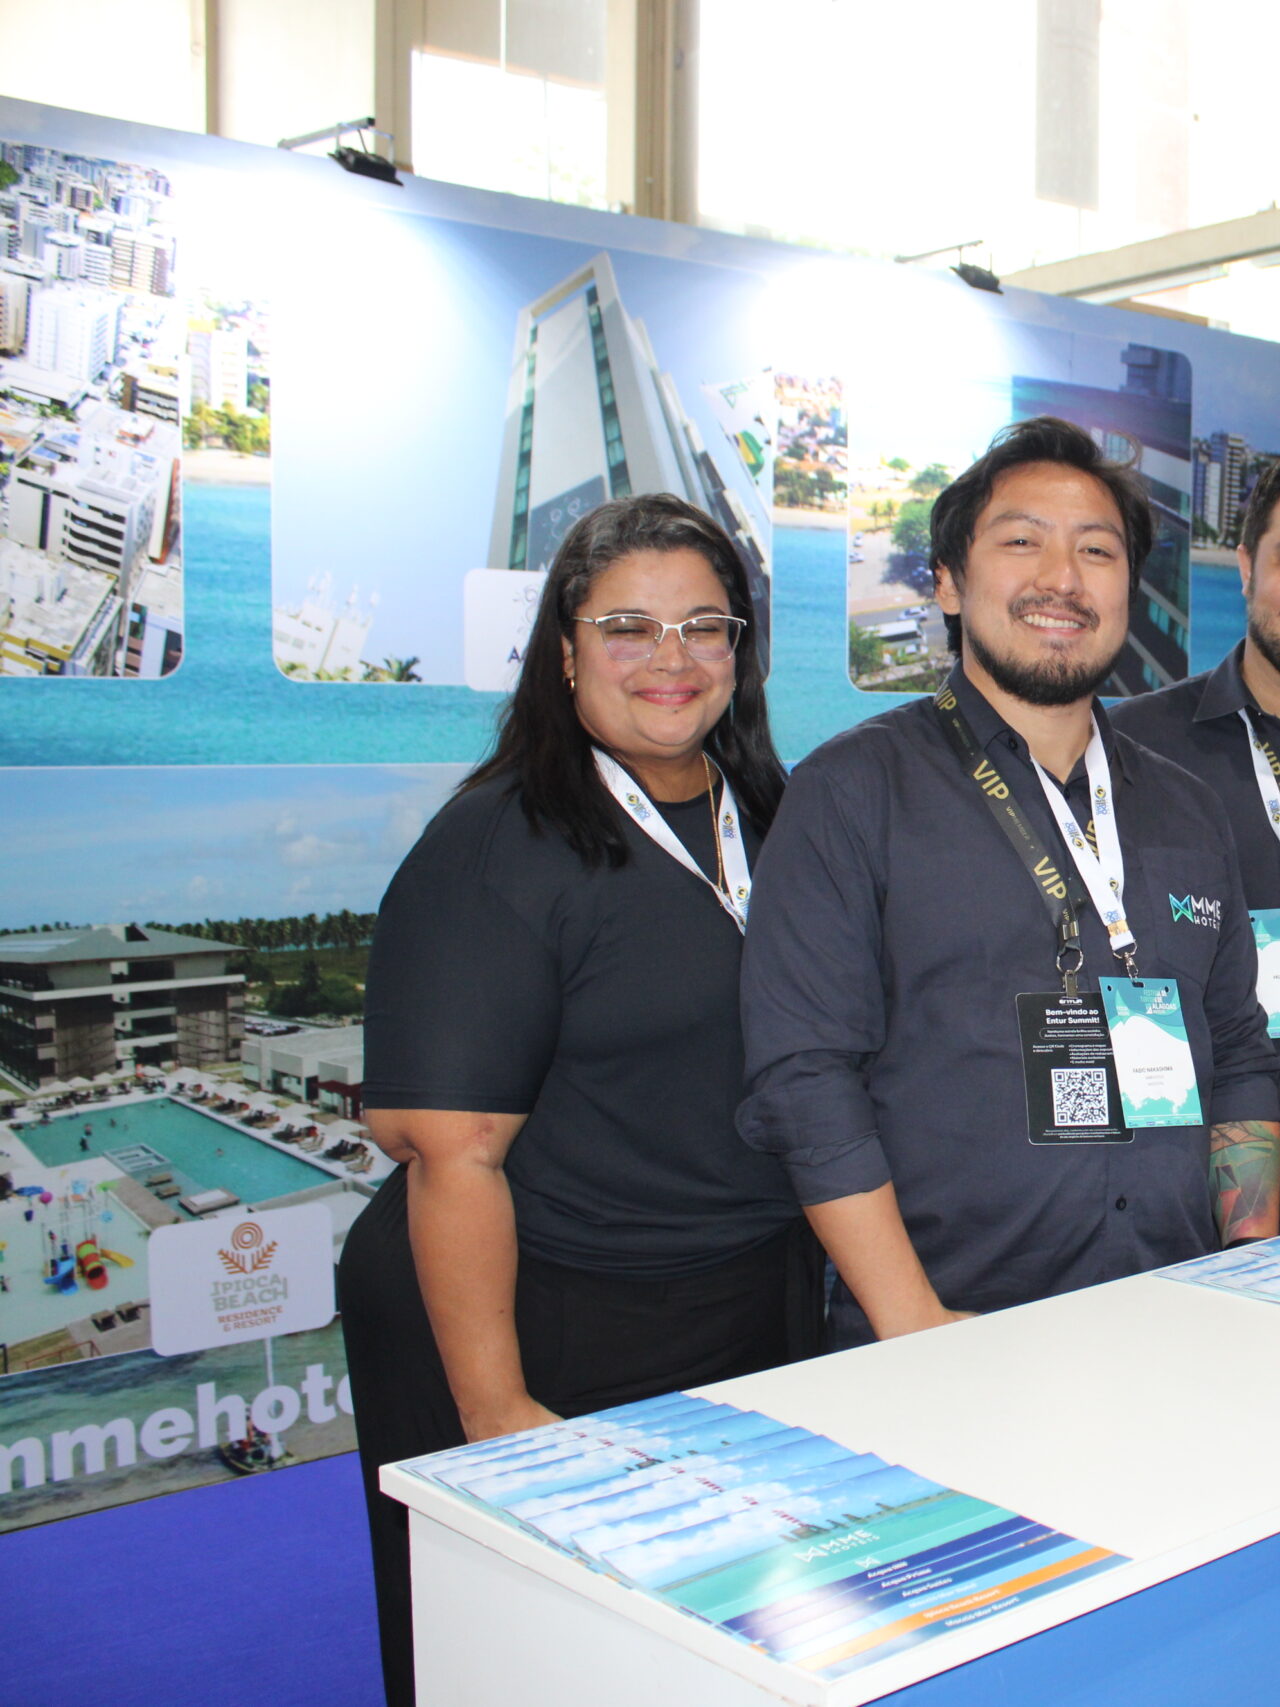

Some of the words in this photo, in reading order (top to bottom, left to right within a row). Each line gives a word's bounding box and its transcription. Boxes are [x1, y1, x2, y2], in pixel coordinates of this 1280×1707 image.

[973, 759, 1010, 800] VIP
[1033, 855, 1067, 899] VIP
[1191, 894, 1221, 921] MME
[1045, 1008, 1088, 1016] Bem-vindo
[1046, 1017, 1067, 1025] Entur
[1068, 1016, 1100, 1024] Summit!
[210, 1273, 281, 1297] IPIOCA
[212, 1277, 288, 1312] BEACH
[0, 1363, 355, 1494] mmehot
